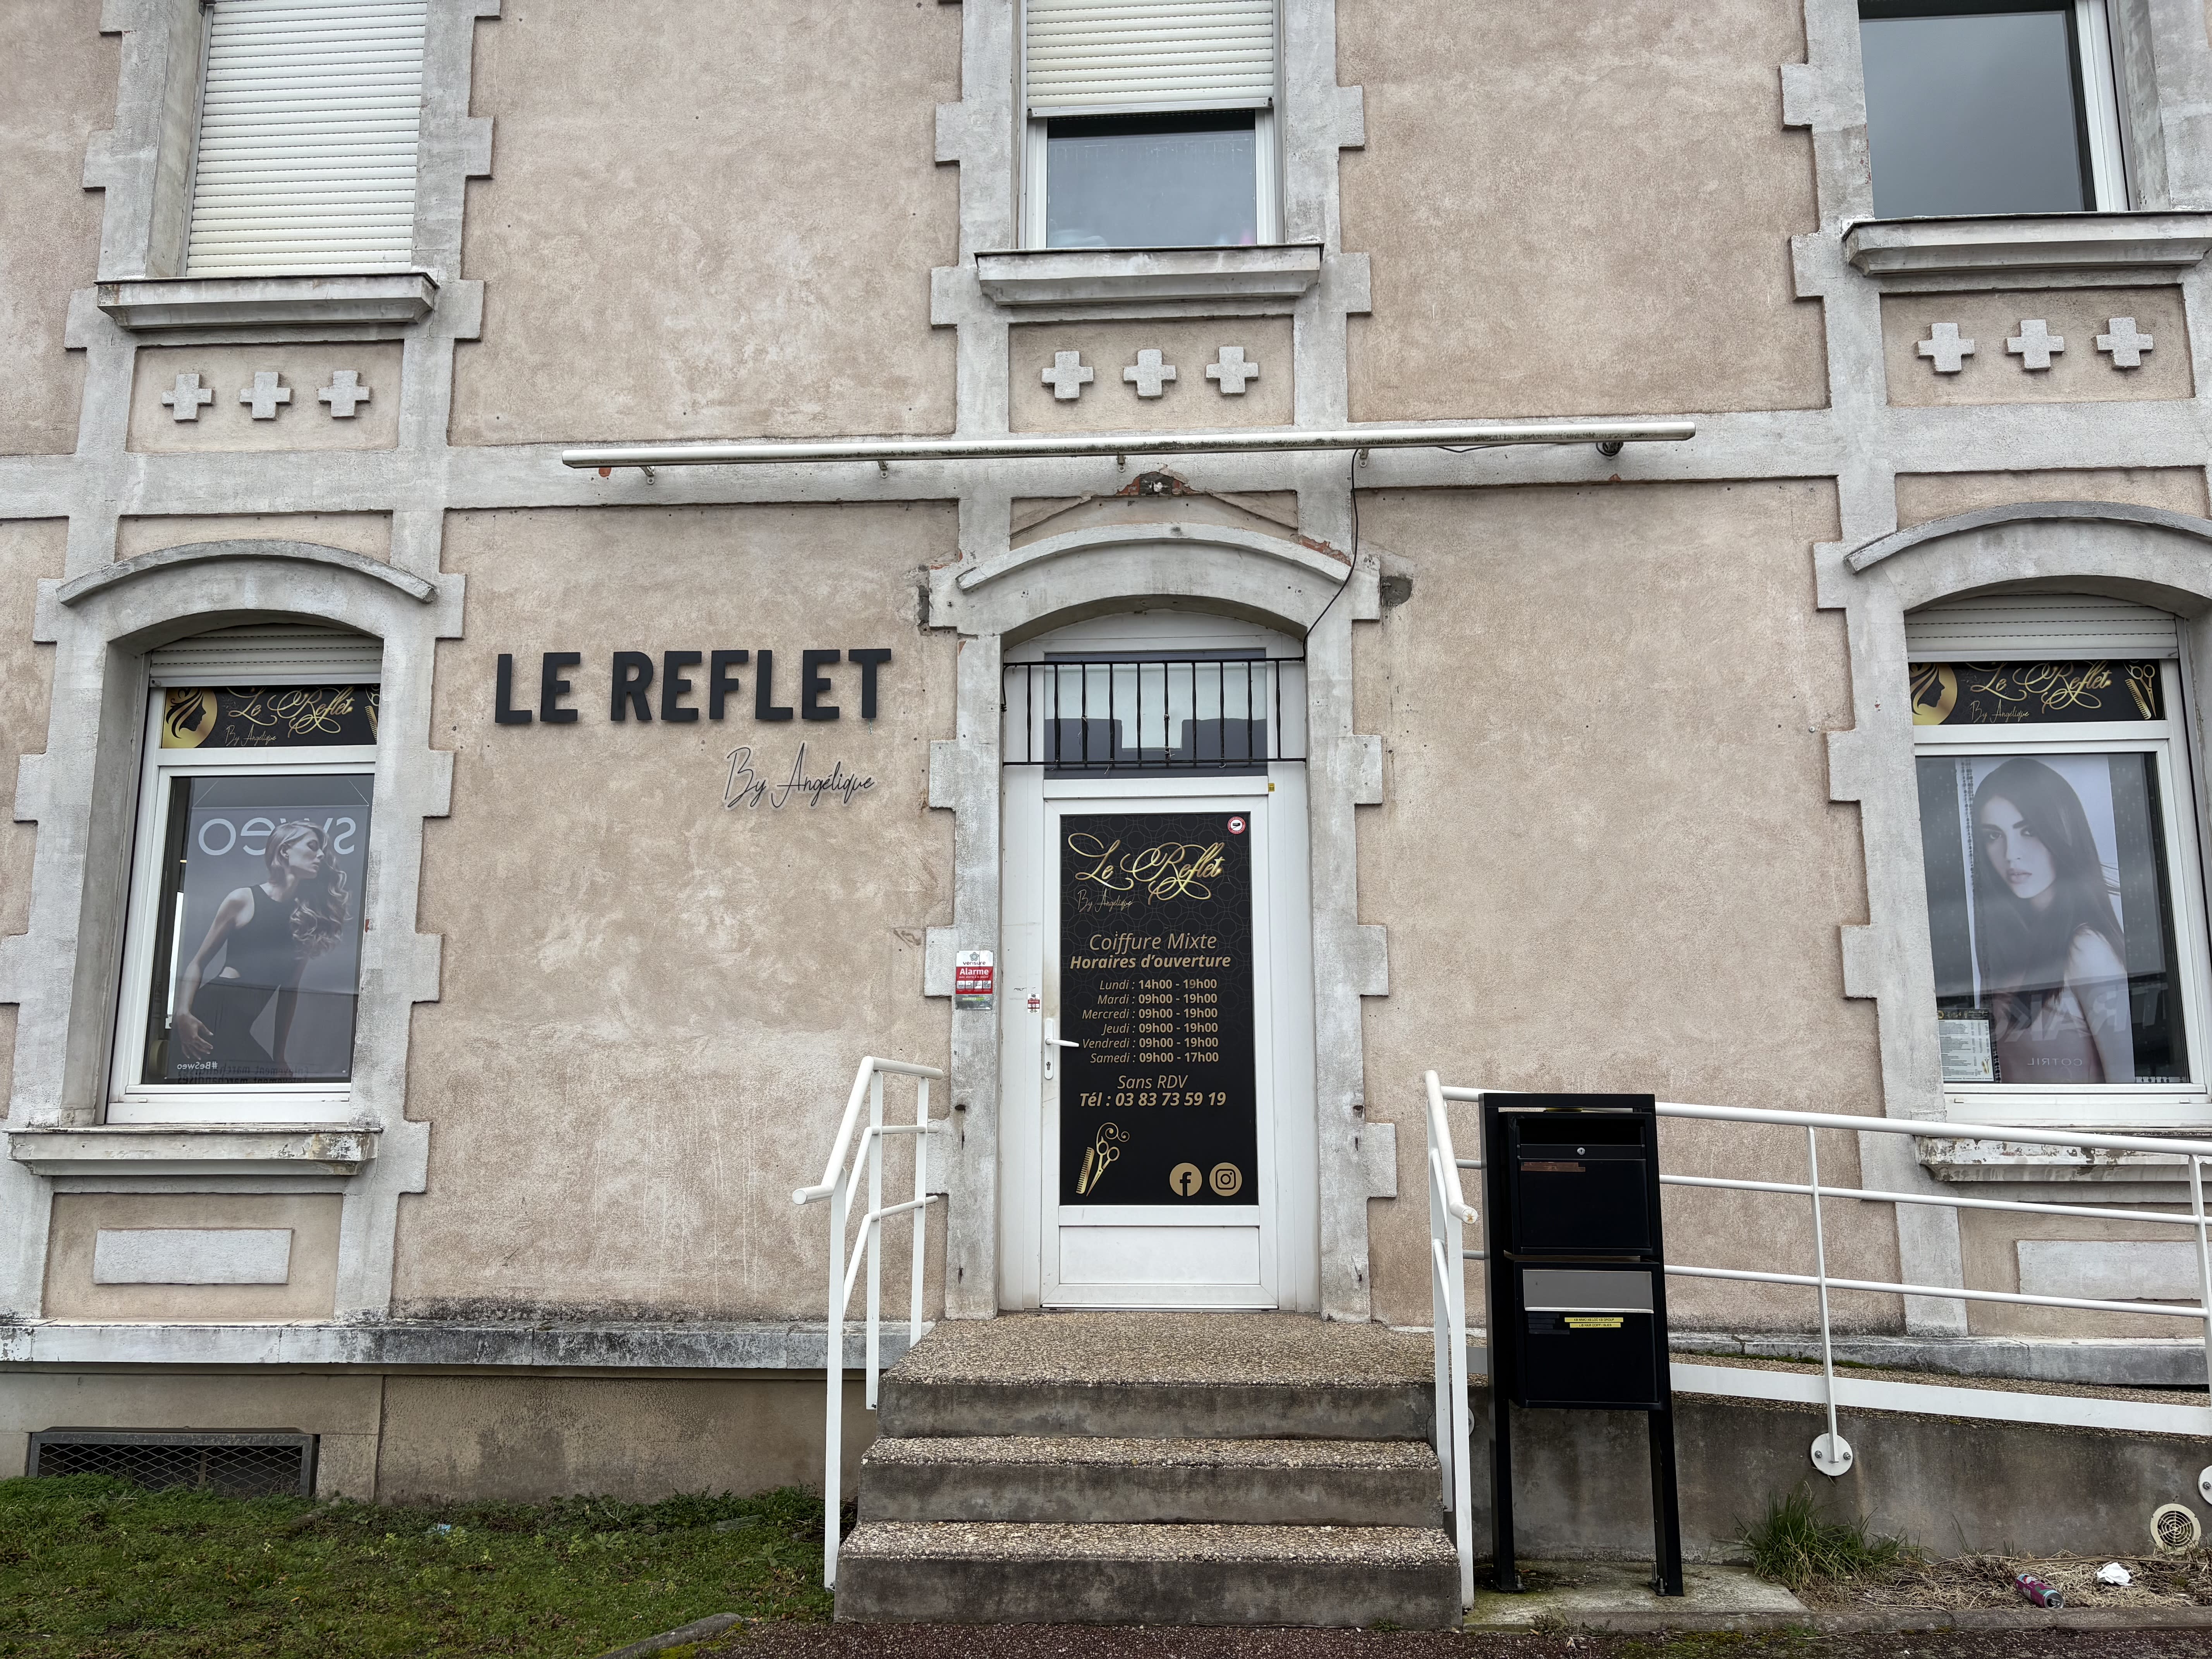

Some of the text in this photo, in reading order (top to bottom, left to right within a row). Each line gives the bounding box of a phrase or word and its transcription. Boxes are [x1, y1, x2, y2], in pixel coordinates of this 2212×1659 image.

[495, 648, 891, 723] LE REFLET
[1965, 660, 2112, 714] Le Reflet
[226, 686, 355, 738] Le Reflet
[1970, 701, 1987, 723] By
[225, 725, 240, 747] By
[725, 742, 875, 808] By Angélique
[1068, 832, 1226, 905] Le Reflet
[1077, 889, 1092, 912] By
[1090, 931, 1216, 954] Coiffure Mixte
[1070, 954, 1230, 969] Horaires d'ouverture
[1100, 979, 1129, 989] Lundi
[1139, 979, 1172, 989] 14h00
[1183, 979, 1217, 988] 19h00
[1098, 994, 1129, 1004] Mardi
[1139, 994, 1172, 1003] 09h00
[1183, 993, 1217, 1003] 19h00
[1082, 1008, 1129, 1019] Mercredi
[1139, 1008, 1173, 1018] 09h00
[1184, 1008, 1218, 1018] 19h00
[1101, 1023, 1129, 1035] Jeudi
[1139, 1023, 1173, 1032] 09h00
[1184, 1022, 1218, 1032] 19h00
[1083, 1038, 1130, 1048] Vendredi
[1139, 1037, 1173, 1047] 09h00
[1185, 1037, 1218, 1047] 19h00
[1091, 1053, 1130, 1063] Samedi
[1140, 1052, 1173, 1062] 09h00
[1185, 1052, 1218, 1062] 17h00
[1118, 1075, 1188, 1089] Sans RDV
[1080, 1092, 1102, 1106] Tél
[1116, 1093, 1133, 1106] 03
[1139, 1093, 1156, 1106] 83
[1162, 1092, 1180, 1106] 73
[1184, 1092, 1202, 1105] 59
[1209, 1092, 1226, 1105] 19
